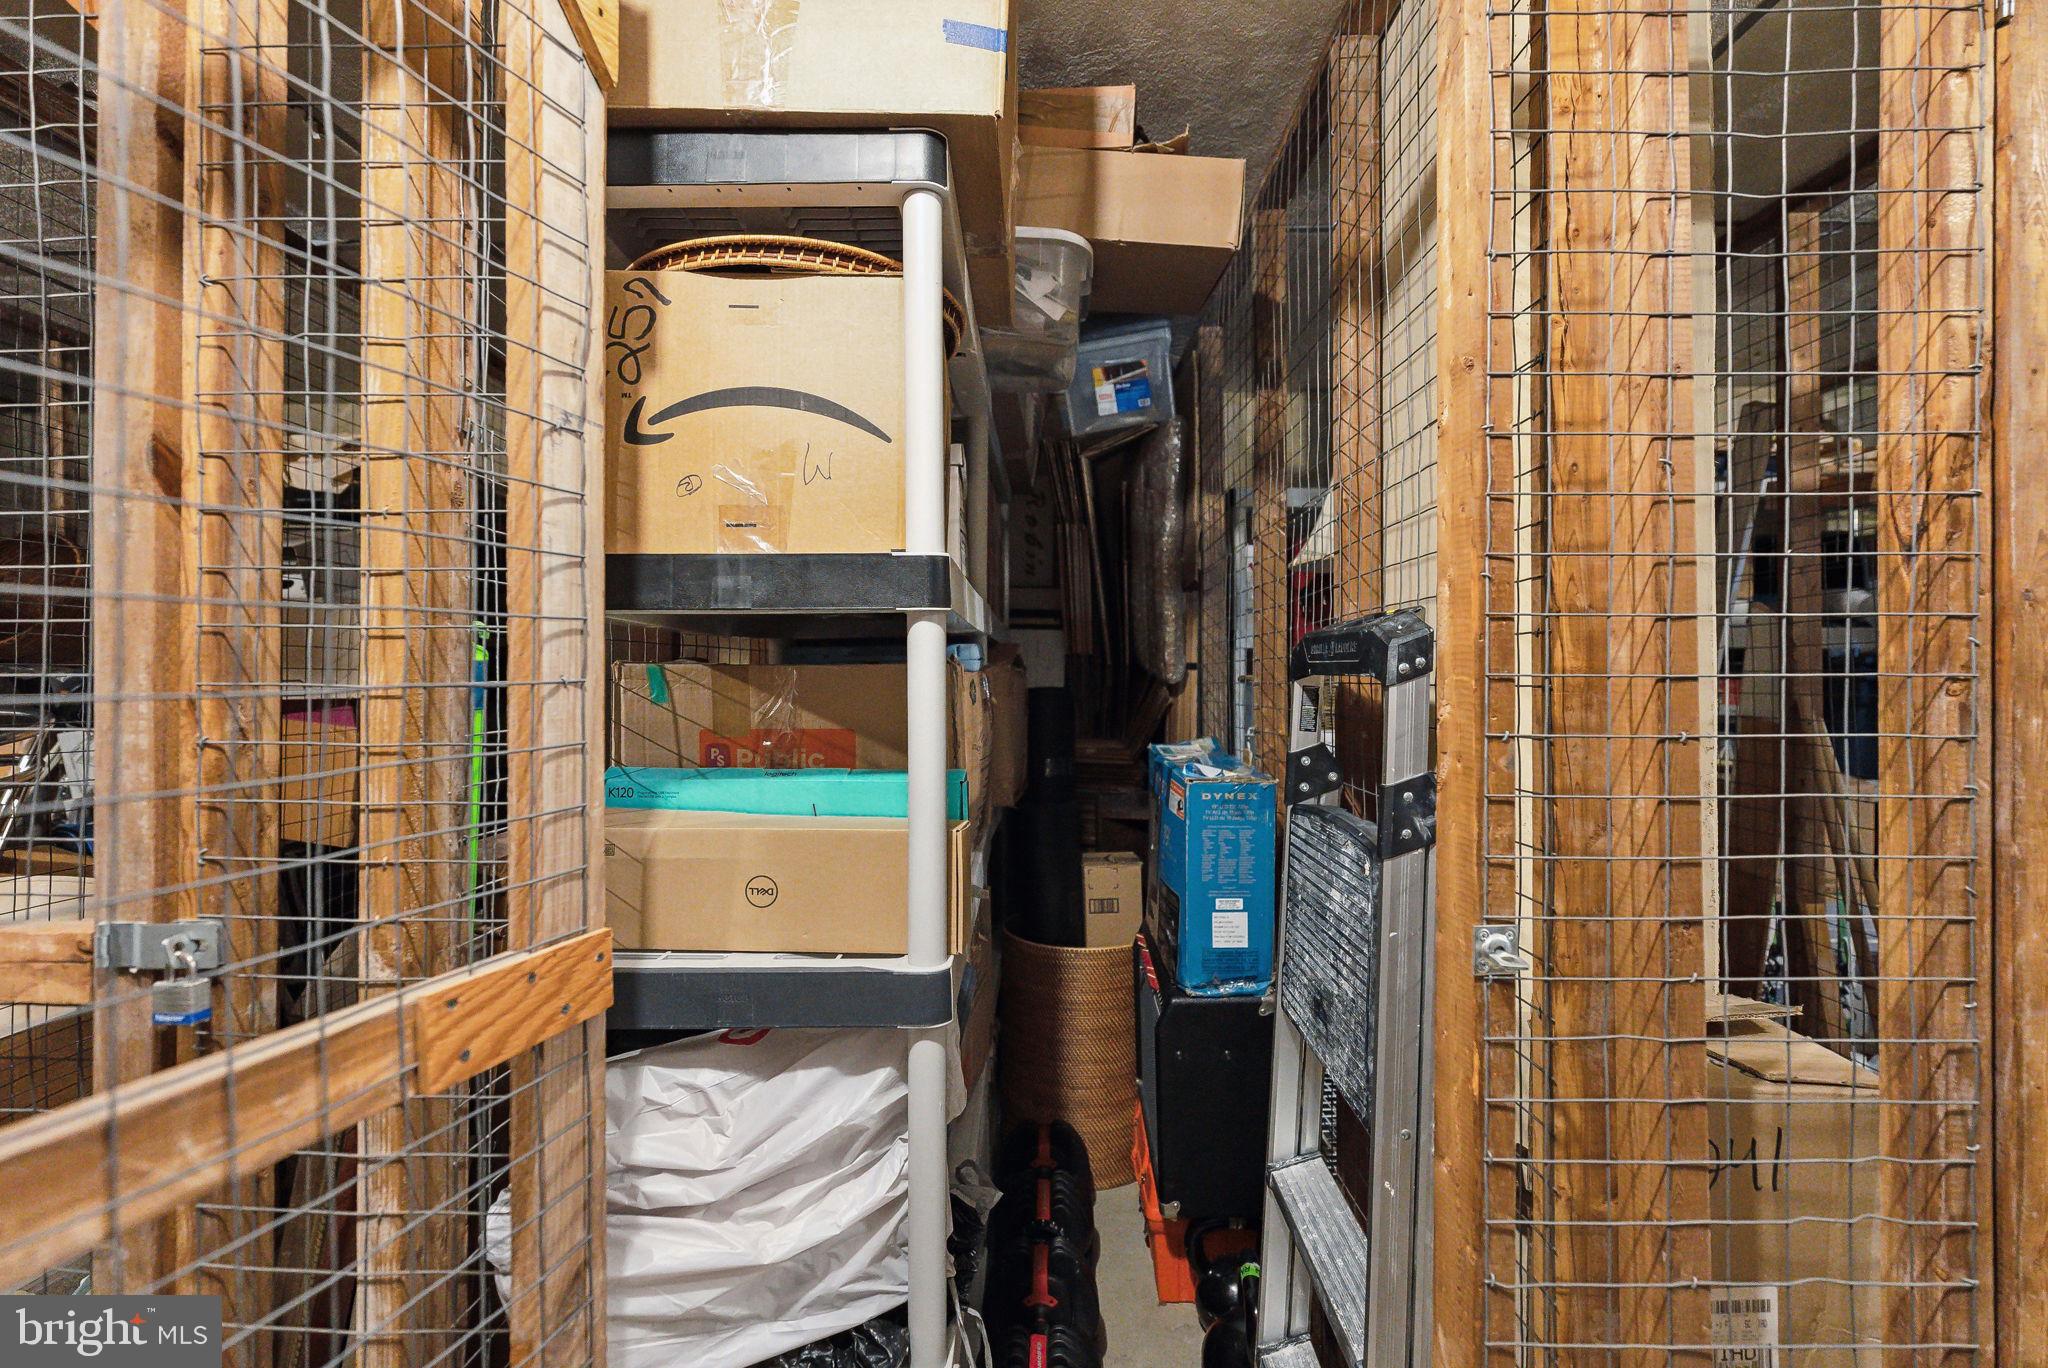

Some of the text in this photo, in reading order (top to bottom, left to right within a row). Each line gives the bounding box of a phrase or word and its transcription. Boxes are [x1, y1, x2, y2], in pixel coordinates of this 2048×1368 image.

[764, 770, 798, 778] logitech
[608, 787, 634, 798] K120
[1201, 792, 1258, 800] DYNEX
[749, 887, 774, 896] DELL
